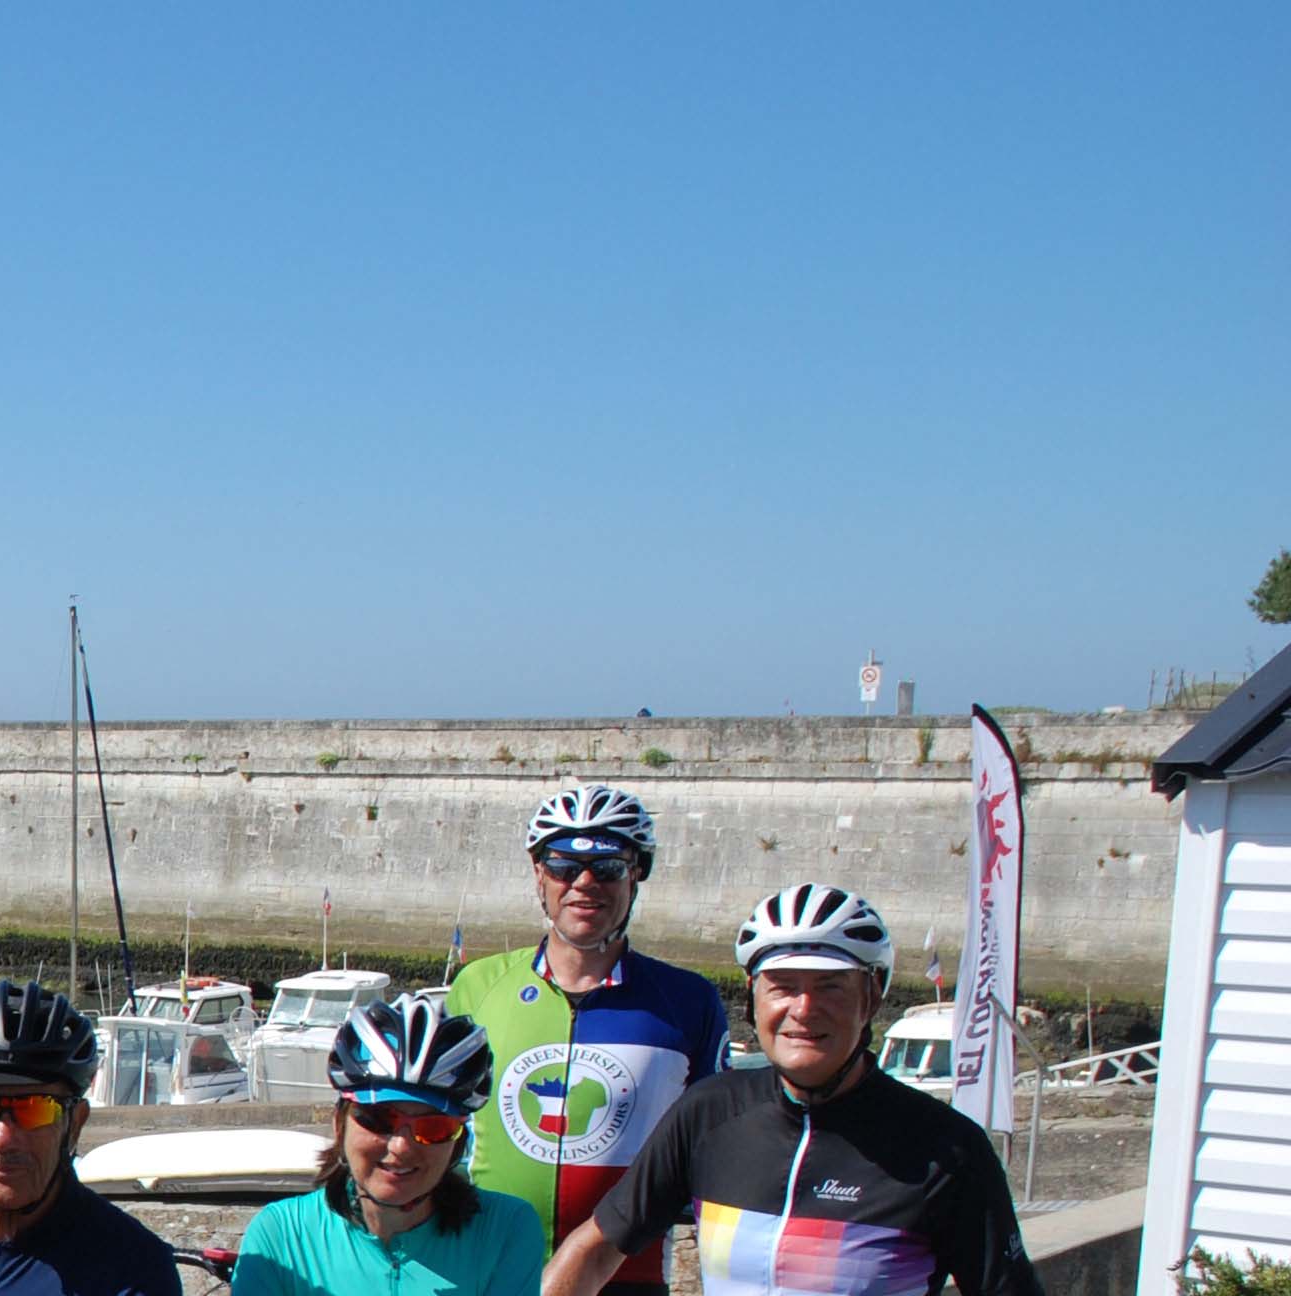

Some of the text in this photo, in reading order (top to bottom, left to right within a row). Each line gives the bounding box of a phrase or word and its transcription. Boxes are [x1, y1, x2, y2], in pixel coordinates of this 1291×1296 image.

[513, 1046, 627, 1081] GREEN JERSEY
[502, 1095, 630, 1161] FRENCH CYCLING TOURS
[812, 1179, 861, 1196] Shutt
